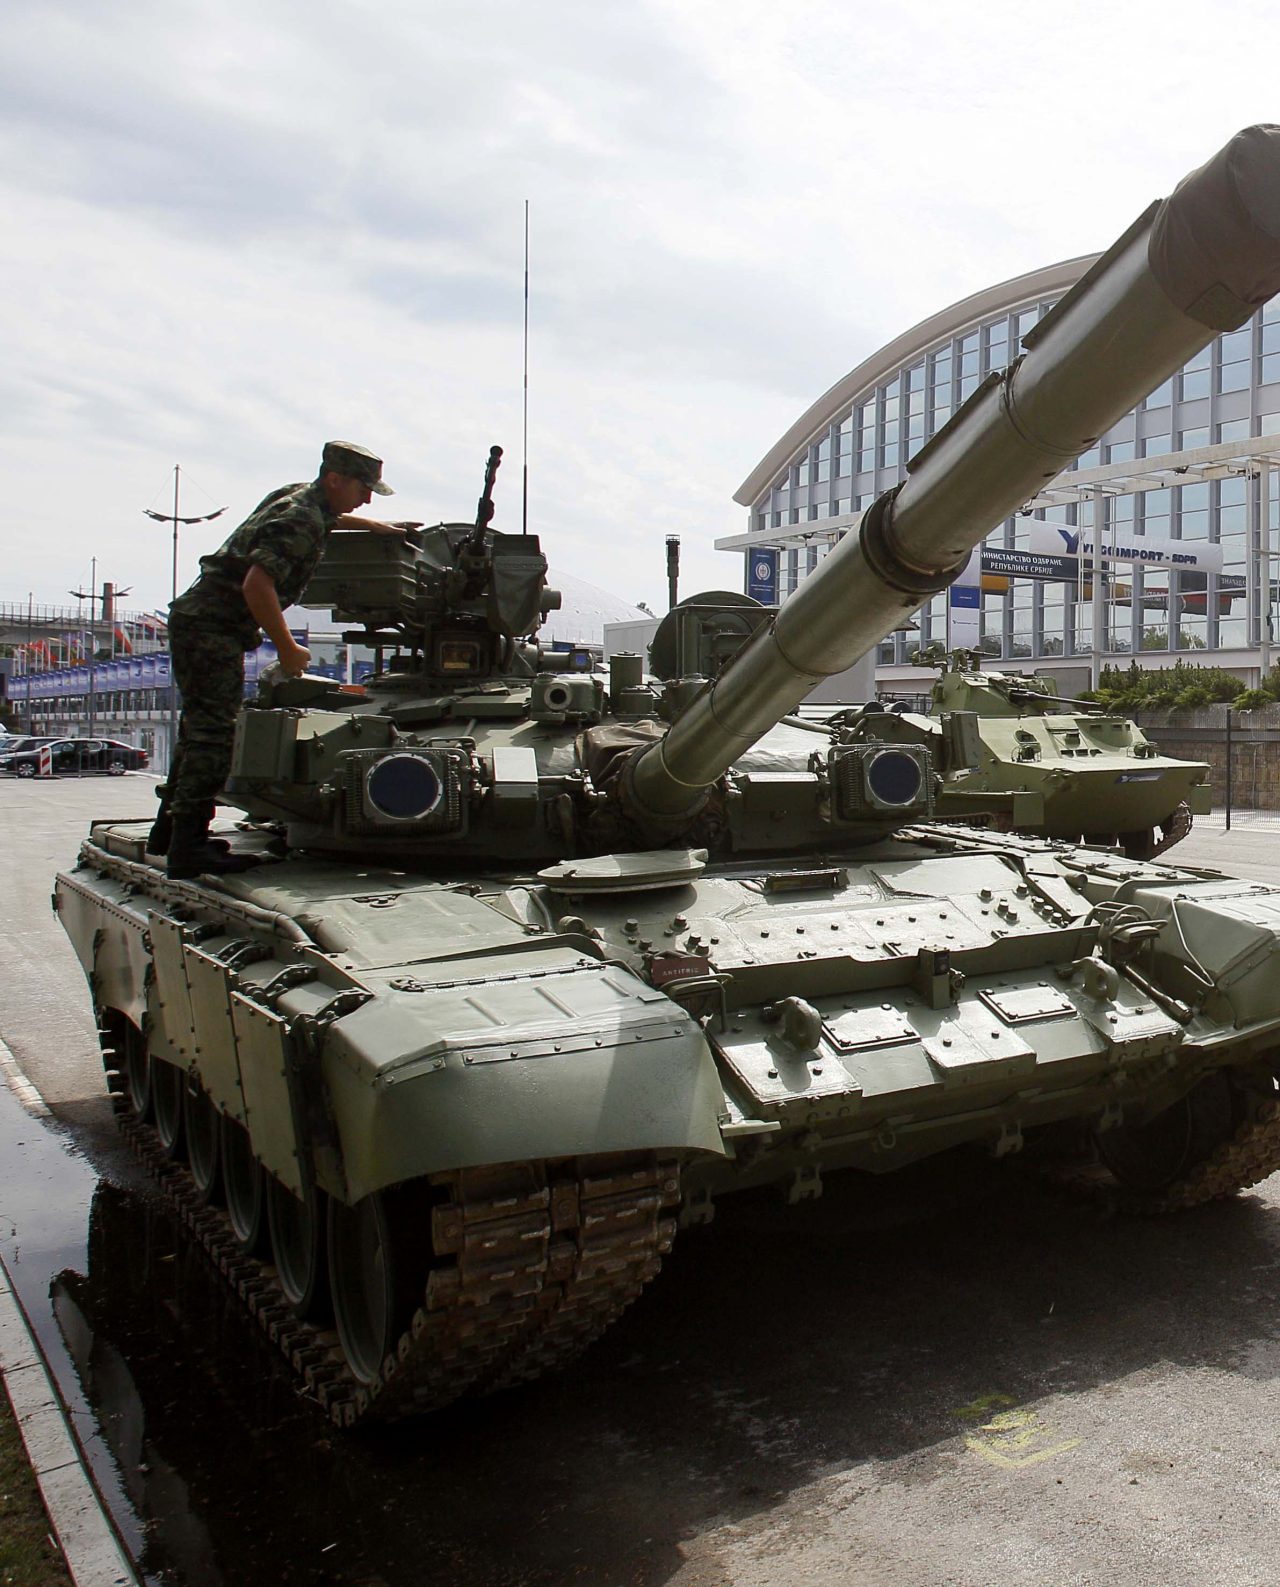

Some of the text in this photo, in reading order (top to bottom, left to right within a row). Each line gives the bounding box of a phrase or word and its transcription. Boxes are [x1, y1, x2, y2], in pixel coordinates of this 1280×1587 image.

[1032, 557, 1063, 567] ОДБРАНЕ
[1171, 553, 1197, 565] SDPR
[990, 562, 1053, 575] РЕПУБЛИКЕ СРБИЈЕ
